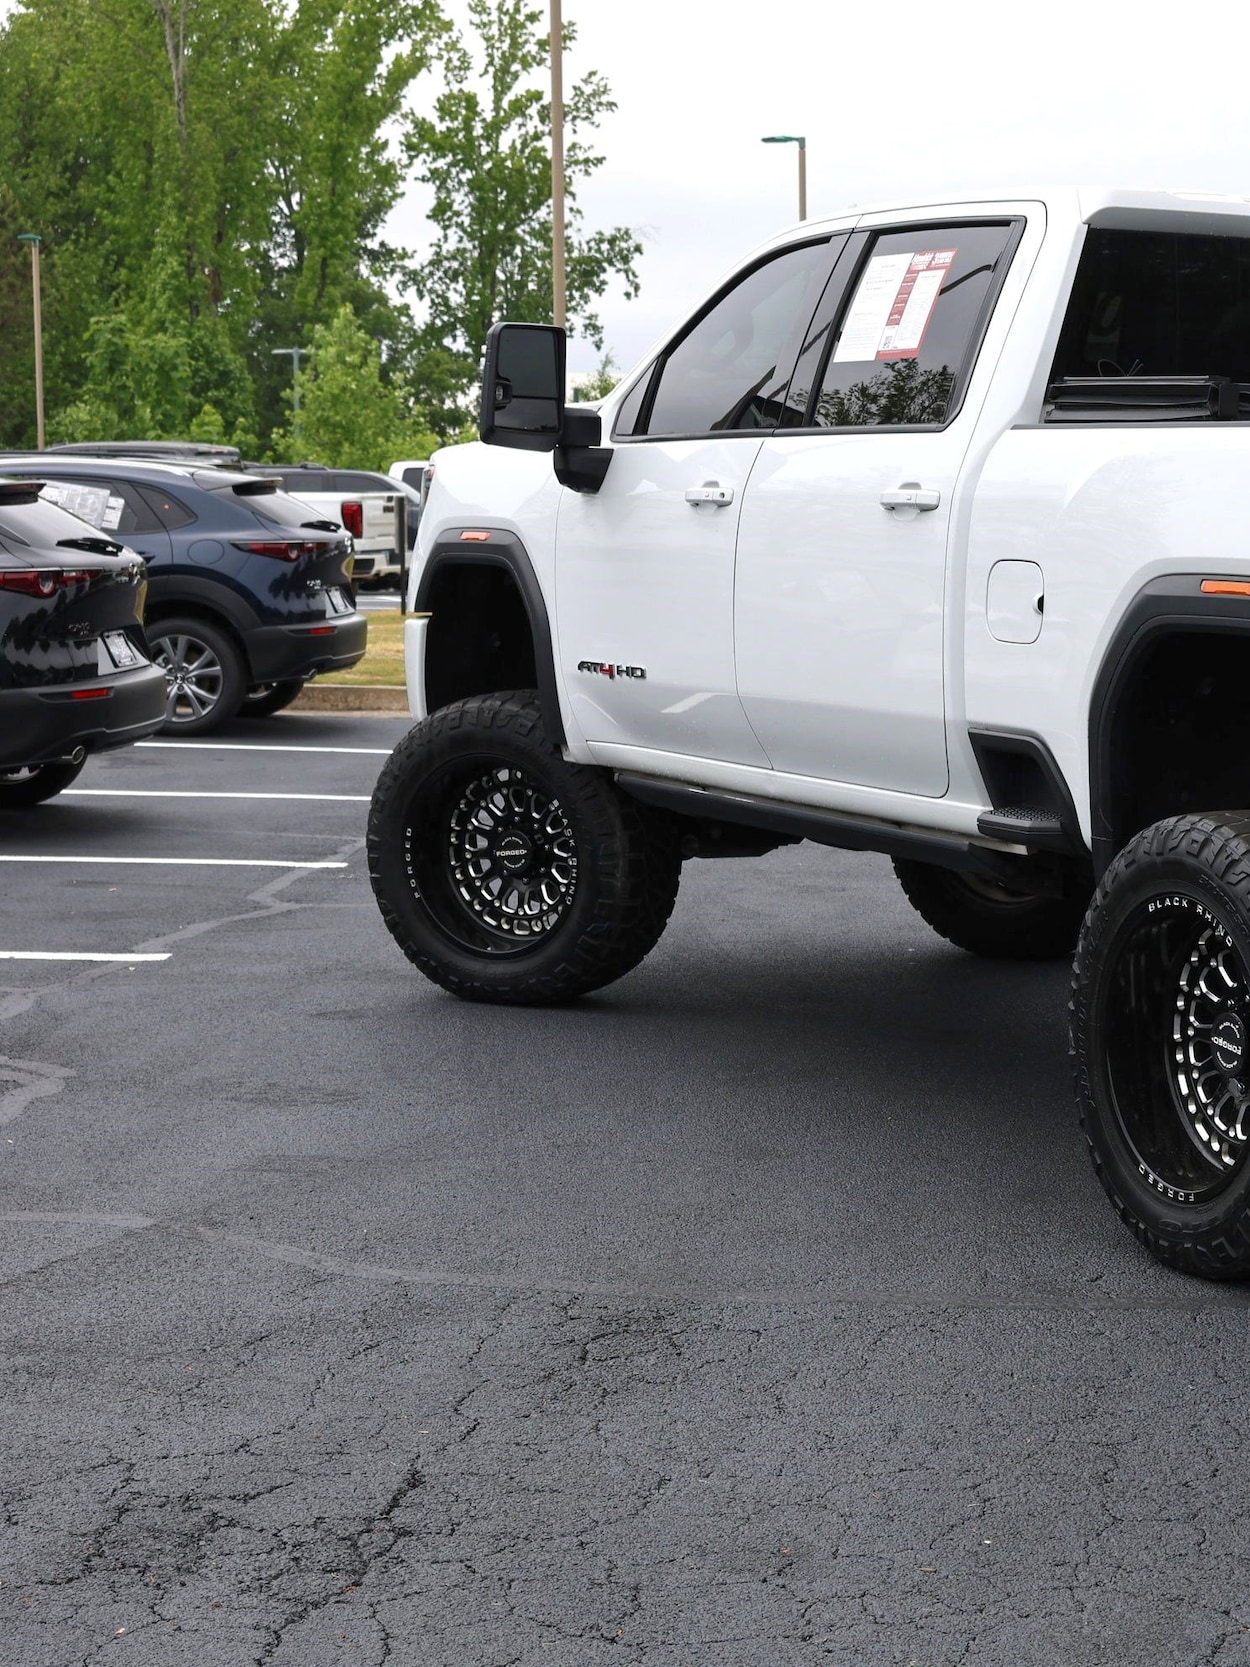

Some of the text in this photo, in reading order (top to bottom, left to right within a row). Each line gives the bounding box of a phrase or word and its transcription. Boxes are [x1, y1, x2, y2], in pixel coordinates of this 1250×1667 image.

[1148, 896, 1233, 947] BLACK RHINO
[1138, 1163, 1195, 1202] FORGED
